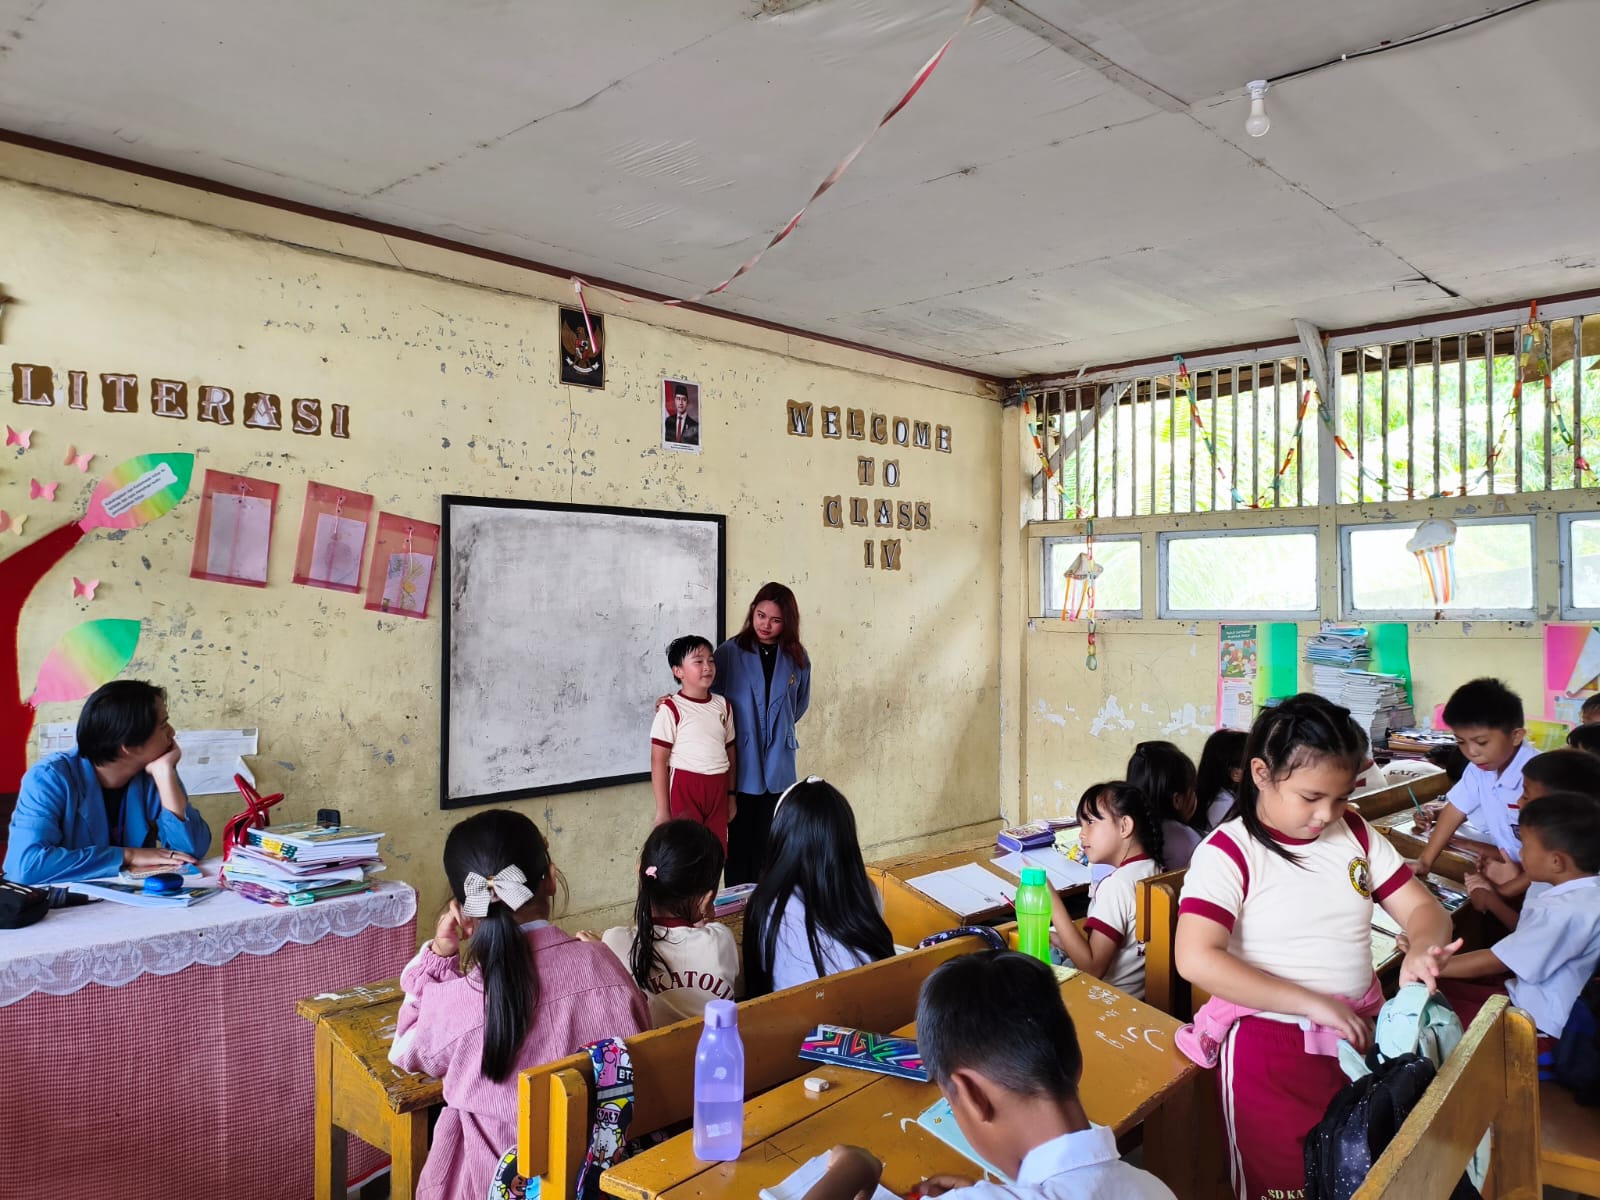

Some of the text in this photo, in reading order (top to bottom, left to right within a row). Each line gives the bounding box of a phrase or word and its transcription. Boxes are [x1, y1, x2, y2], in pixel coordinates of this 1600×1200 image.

[16, 364, 347, 438] LITERASI
[789, 404, 951, 452] WELCOME
[858, 458, 899, 487] TO
[826, 498, 929, 529] CLASS
[865, 542, 900, 570] IV
[648, 970, 734, 1000] KATOLI
[1267, 1189, 1284, 1199] SD
